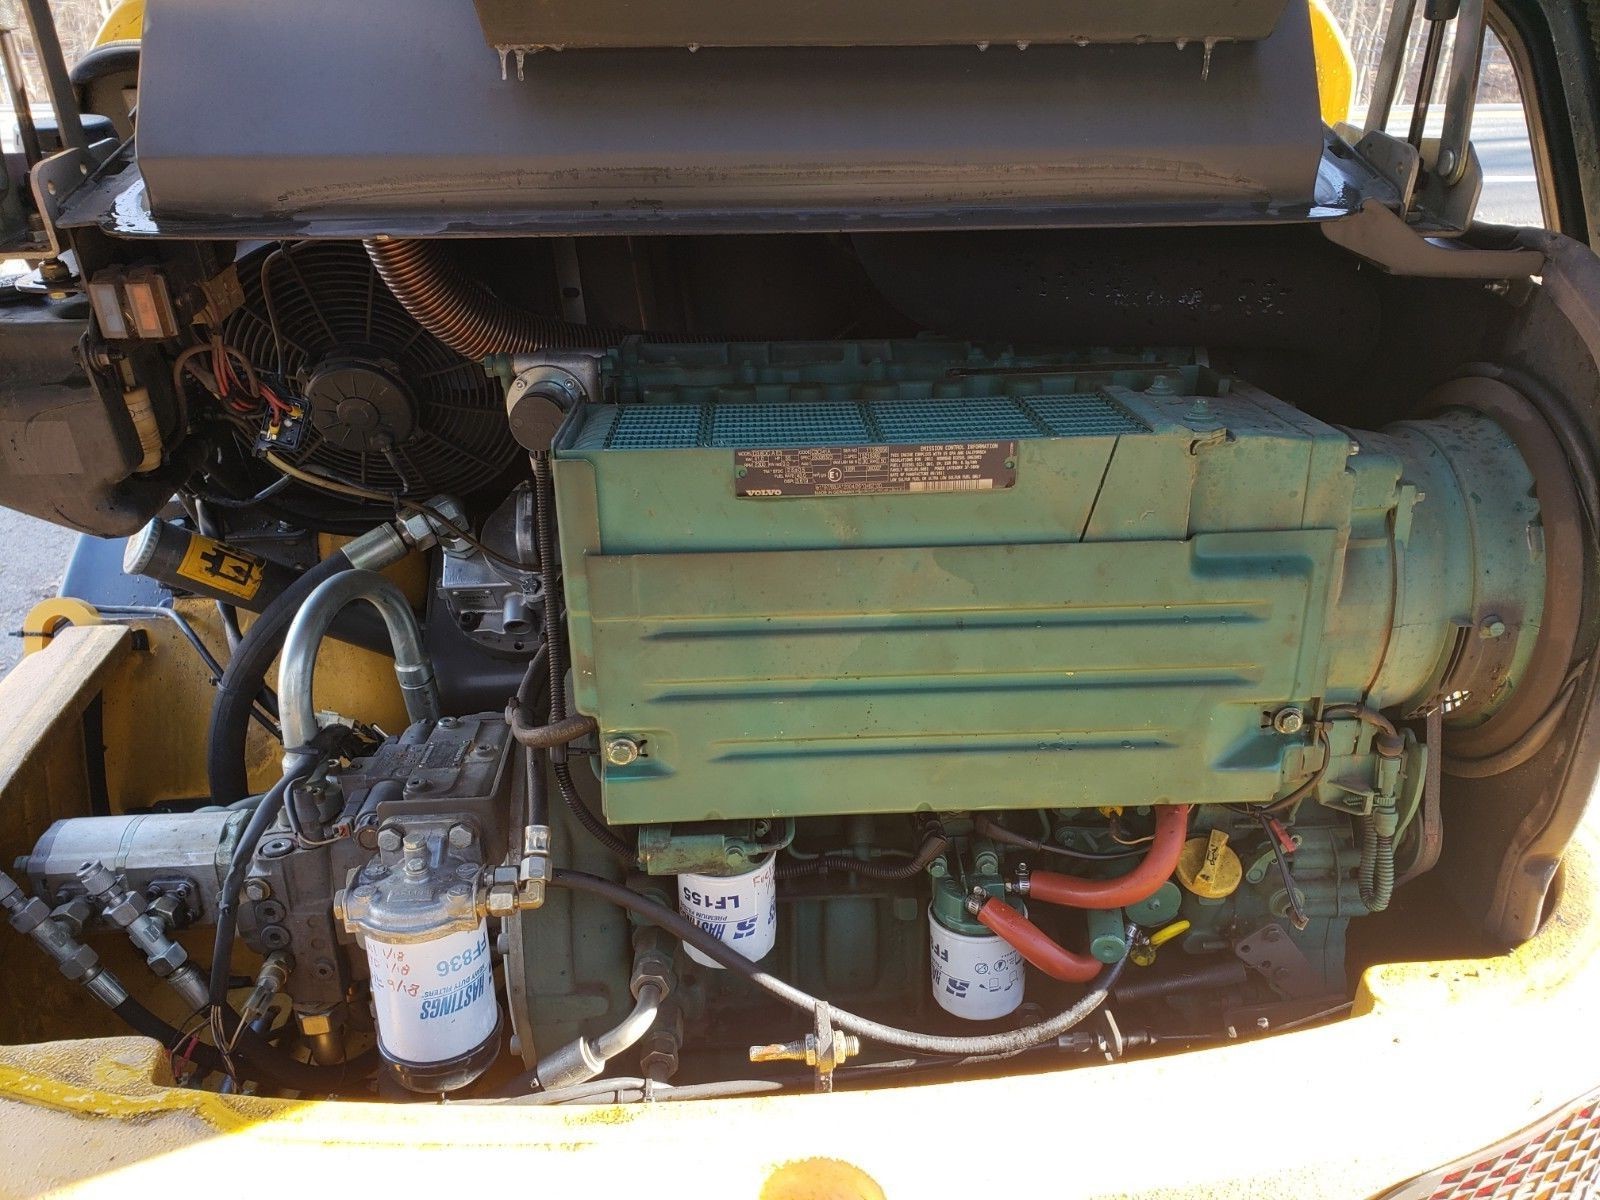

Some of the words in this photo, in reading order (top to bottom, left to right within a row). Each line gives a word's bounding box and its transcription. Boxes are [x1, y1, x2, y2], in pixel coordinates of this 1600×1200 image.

[683, 886, 740, 910] LF155
[696, 912, 728, 921] PREMIUM
[436, 930, 488, 977] FF836
[472, 963, 486, 980] HEAVY
[422, 984, 452, 998] FILTERS
[453, 975, 471, 992] DUTY
[420, 974, 485, 1020] HASTINGS
